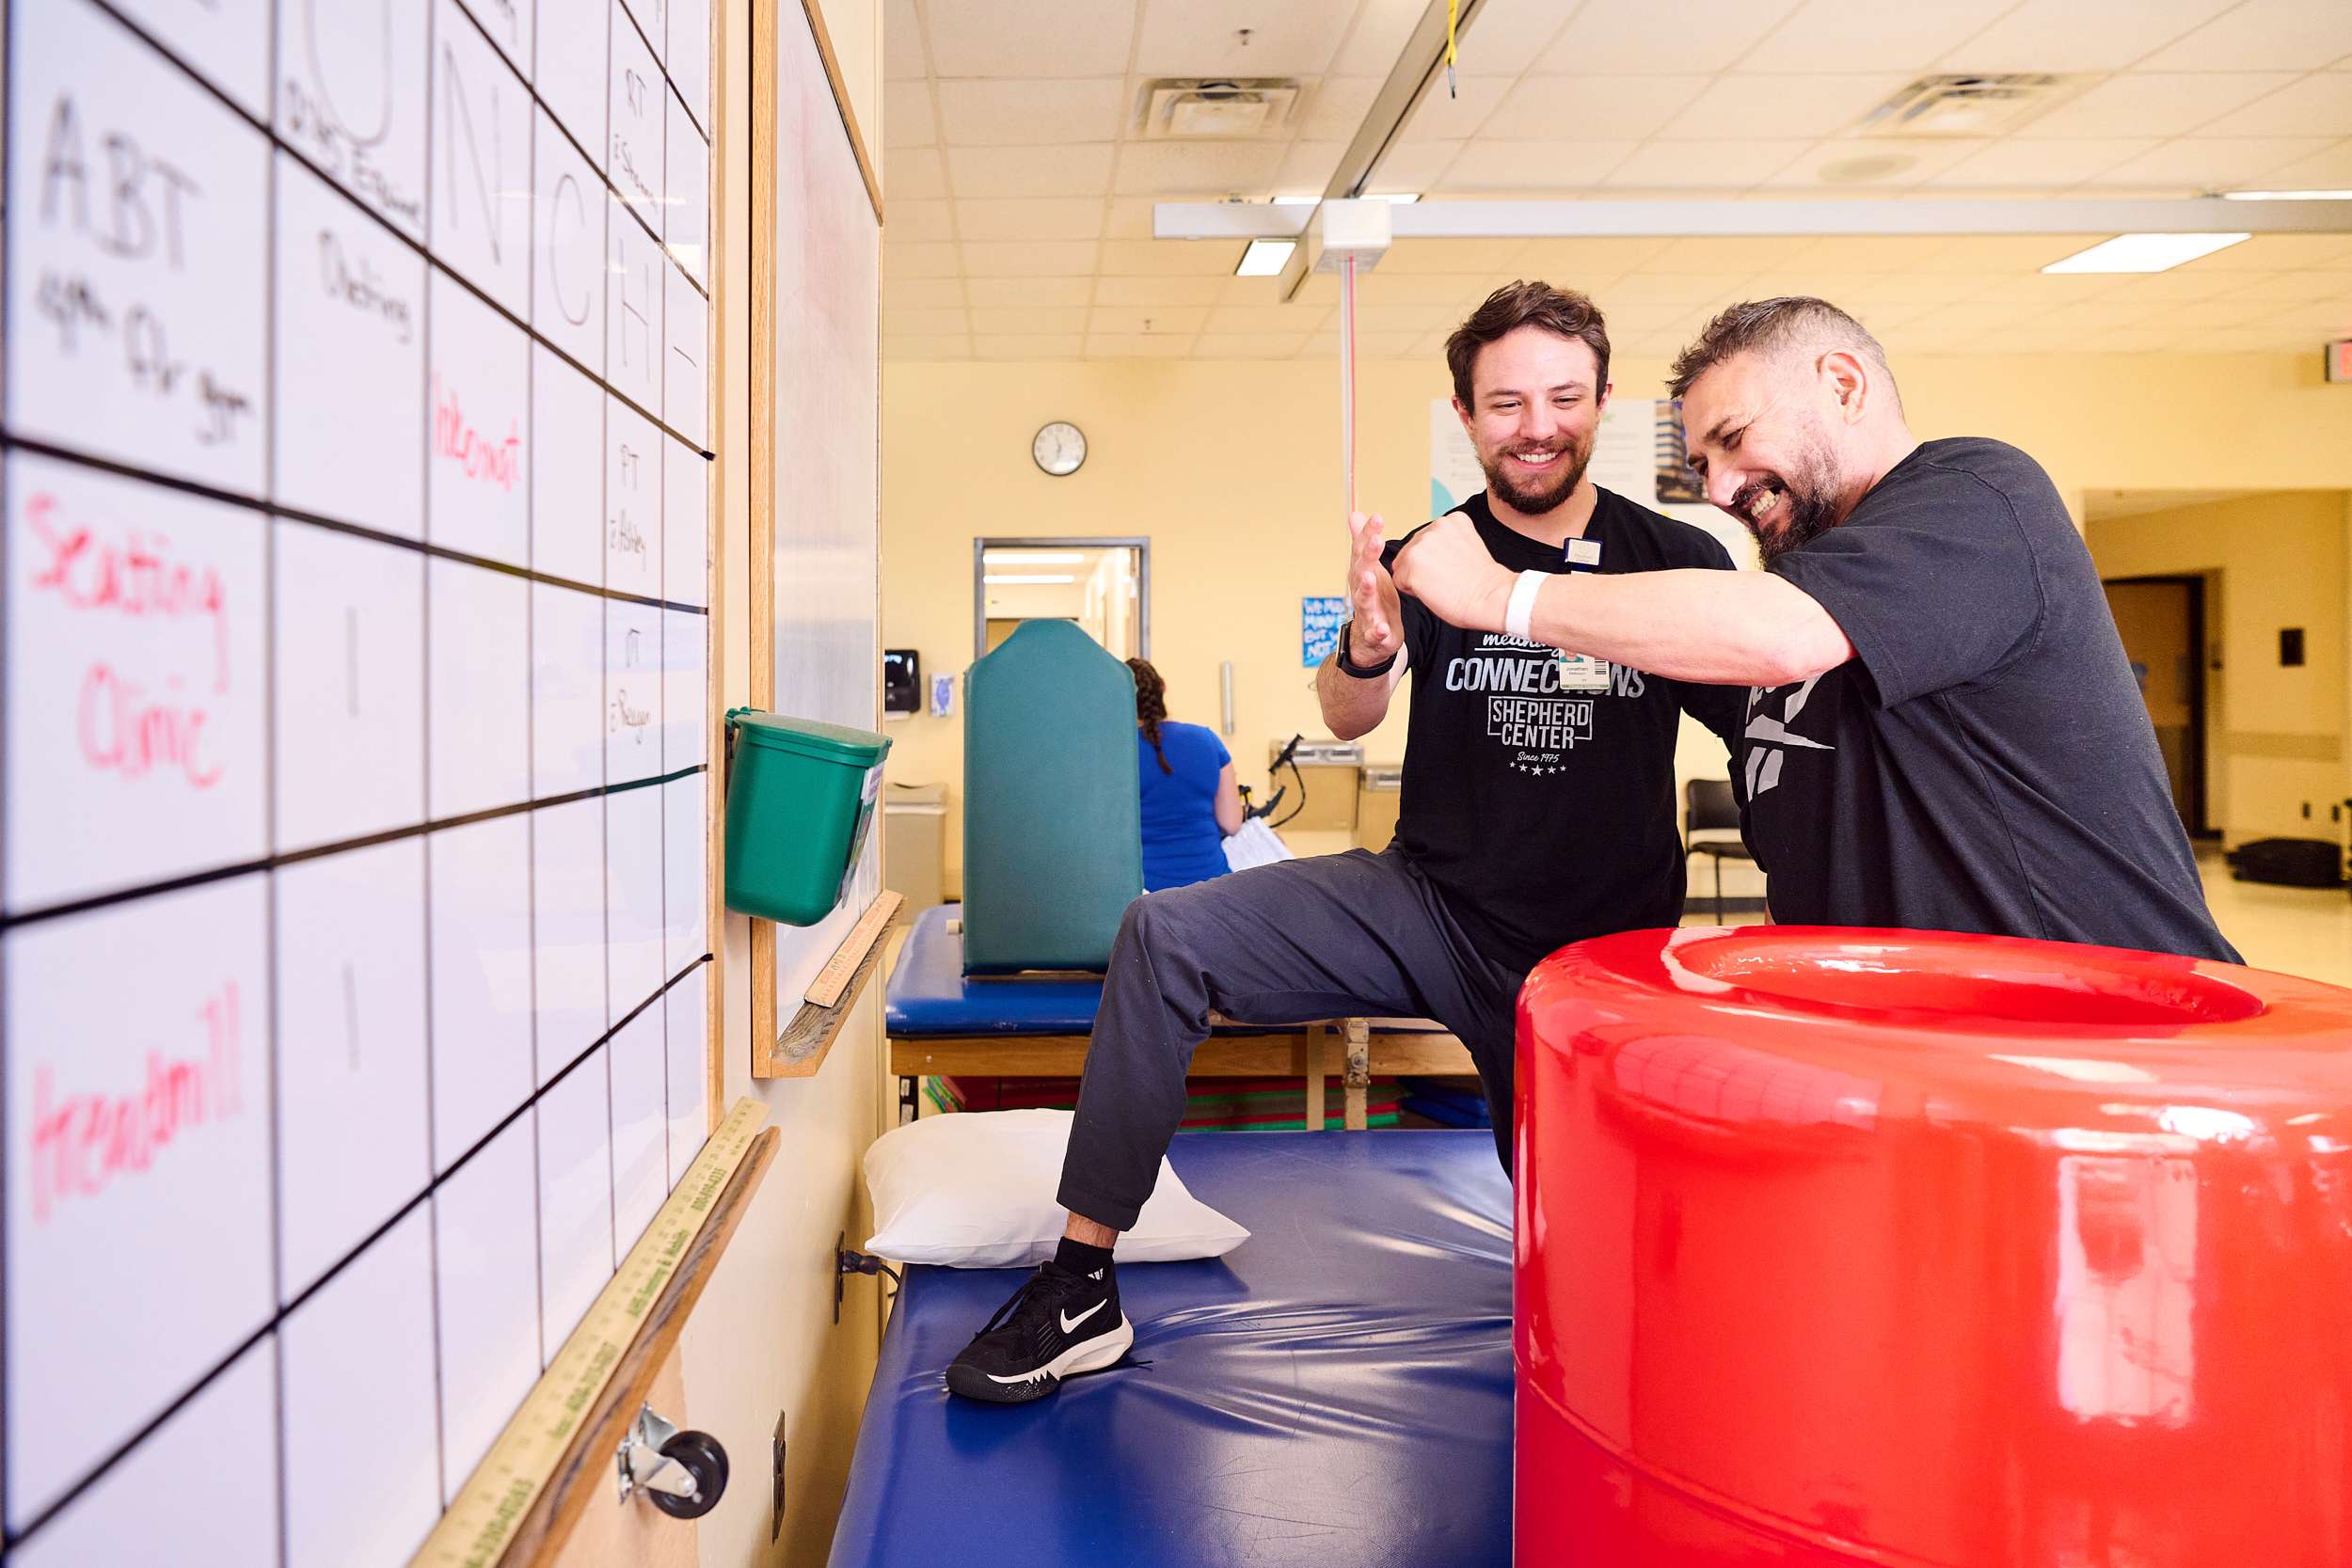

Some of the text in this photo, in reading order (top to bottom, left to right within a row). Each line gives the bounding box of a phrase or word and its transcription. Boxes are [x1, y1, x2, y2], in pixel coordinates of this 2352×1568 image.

[40, 92, 202, 272] ABT
[26, 491, 230, 696] Seating
[1446, 657, 1645, 699] CONNECNS
[77, 660, 224, 792] Clinic
[1492, 700, 1590, 726] SHEPHERD
[1502, 722, 1574, 750] CENTER
[1517, 751, 1560, 764] Since 1975
